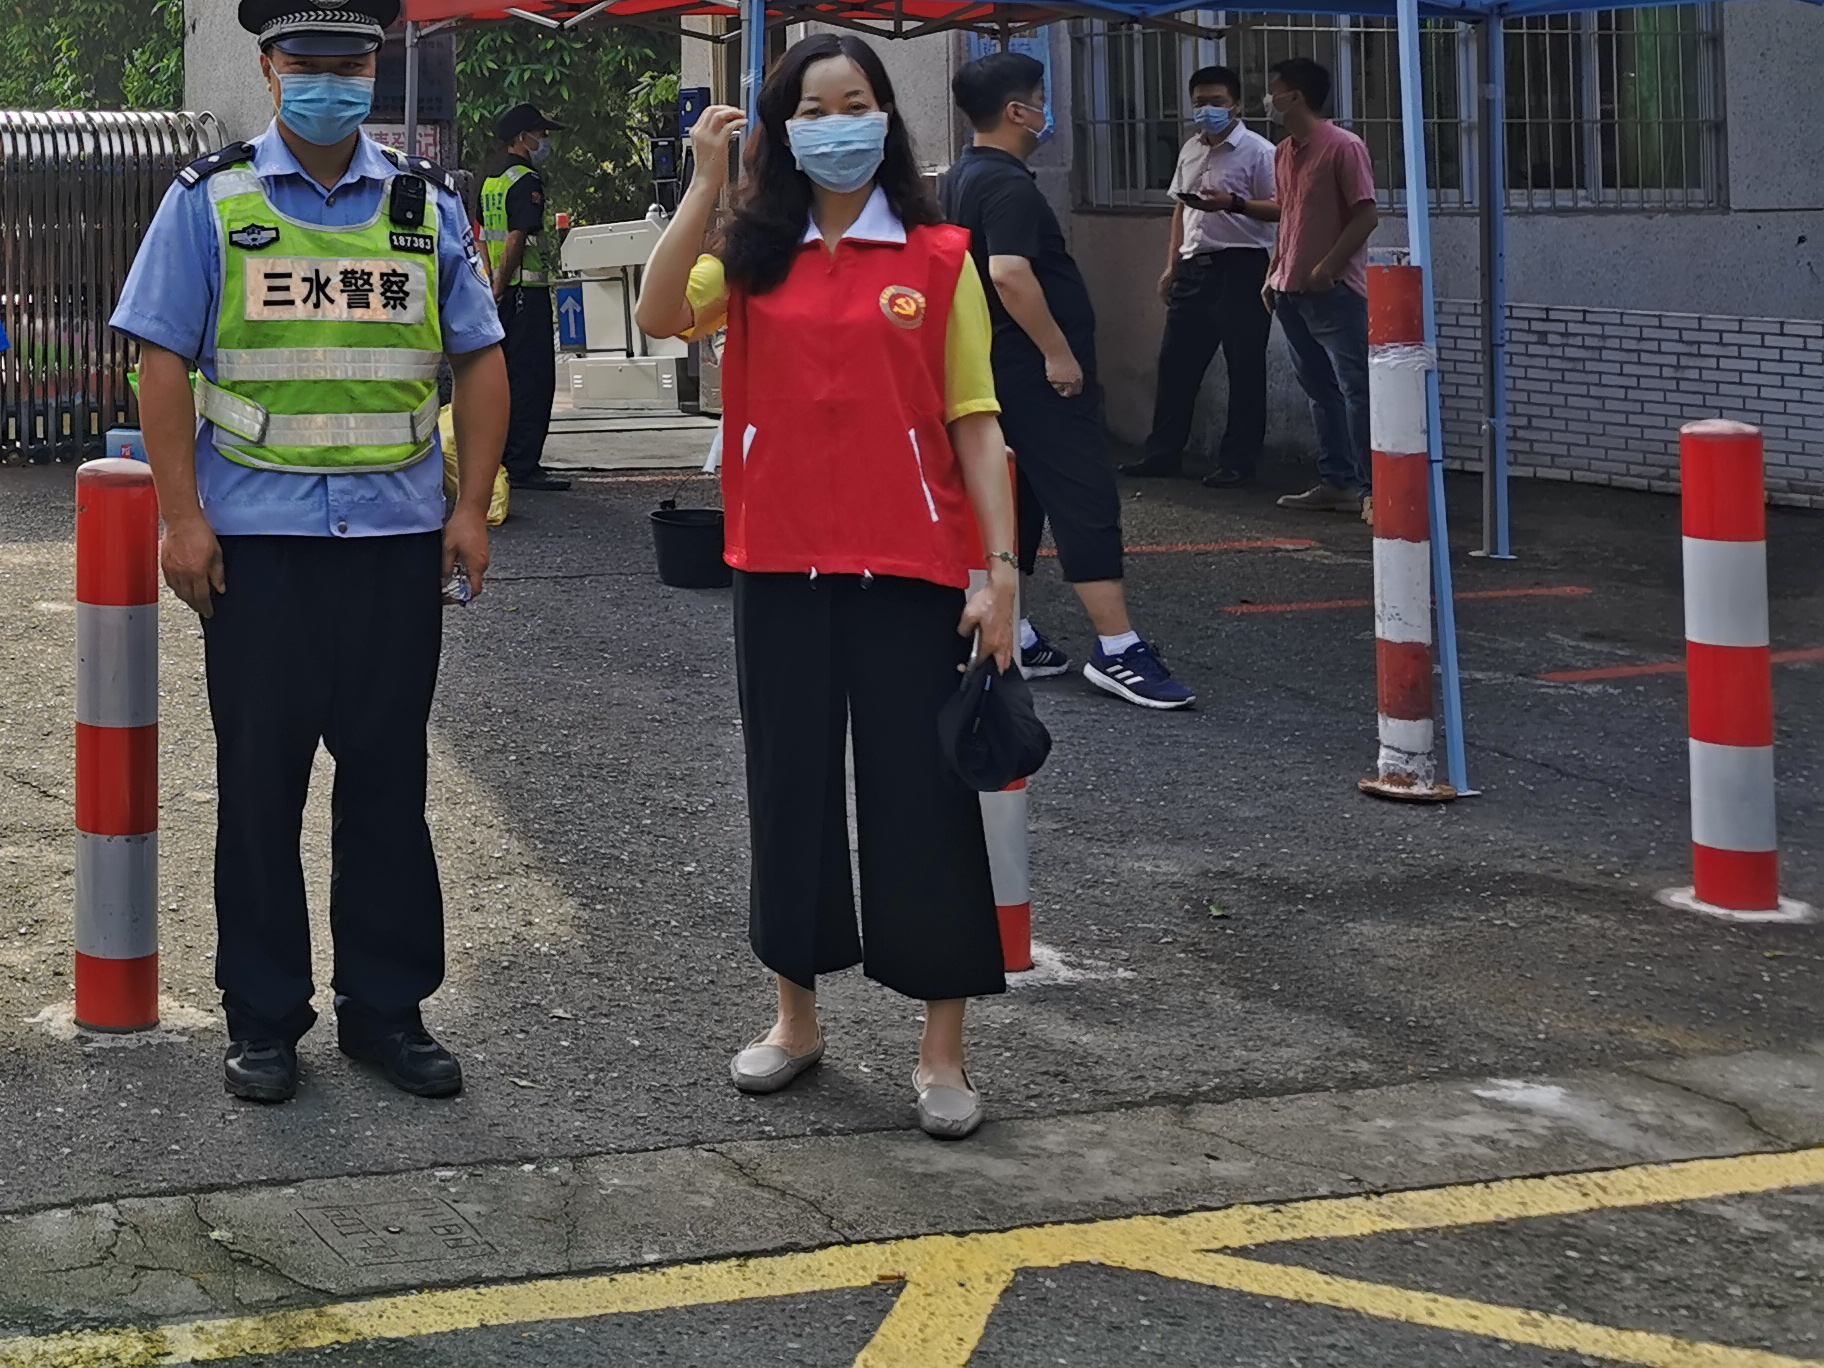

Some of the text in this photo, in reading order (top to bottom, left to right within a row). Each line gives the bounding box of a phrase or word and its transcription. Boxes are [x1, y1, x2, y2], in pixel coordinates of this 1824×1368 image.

[392, 234, 432, 250] 187383
[262, 268, 412, 312] 三水警察
